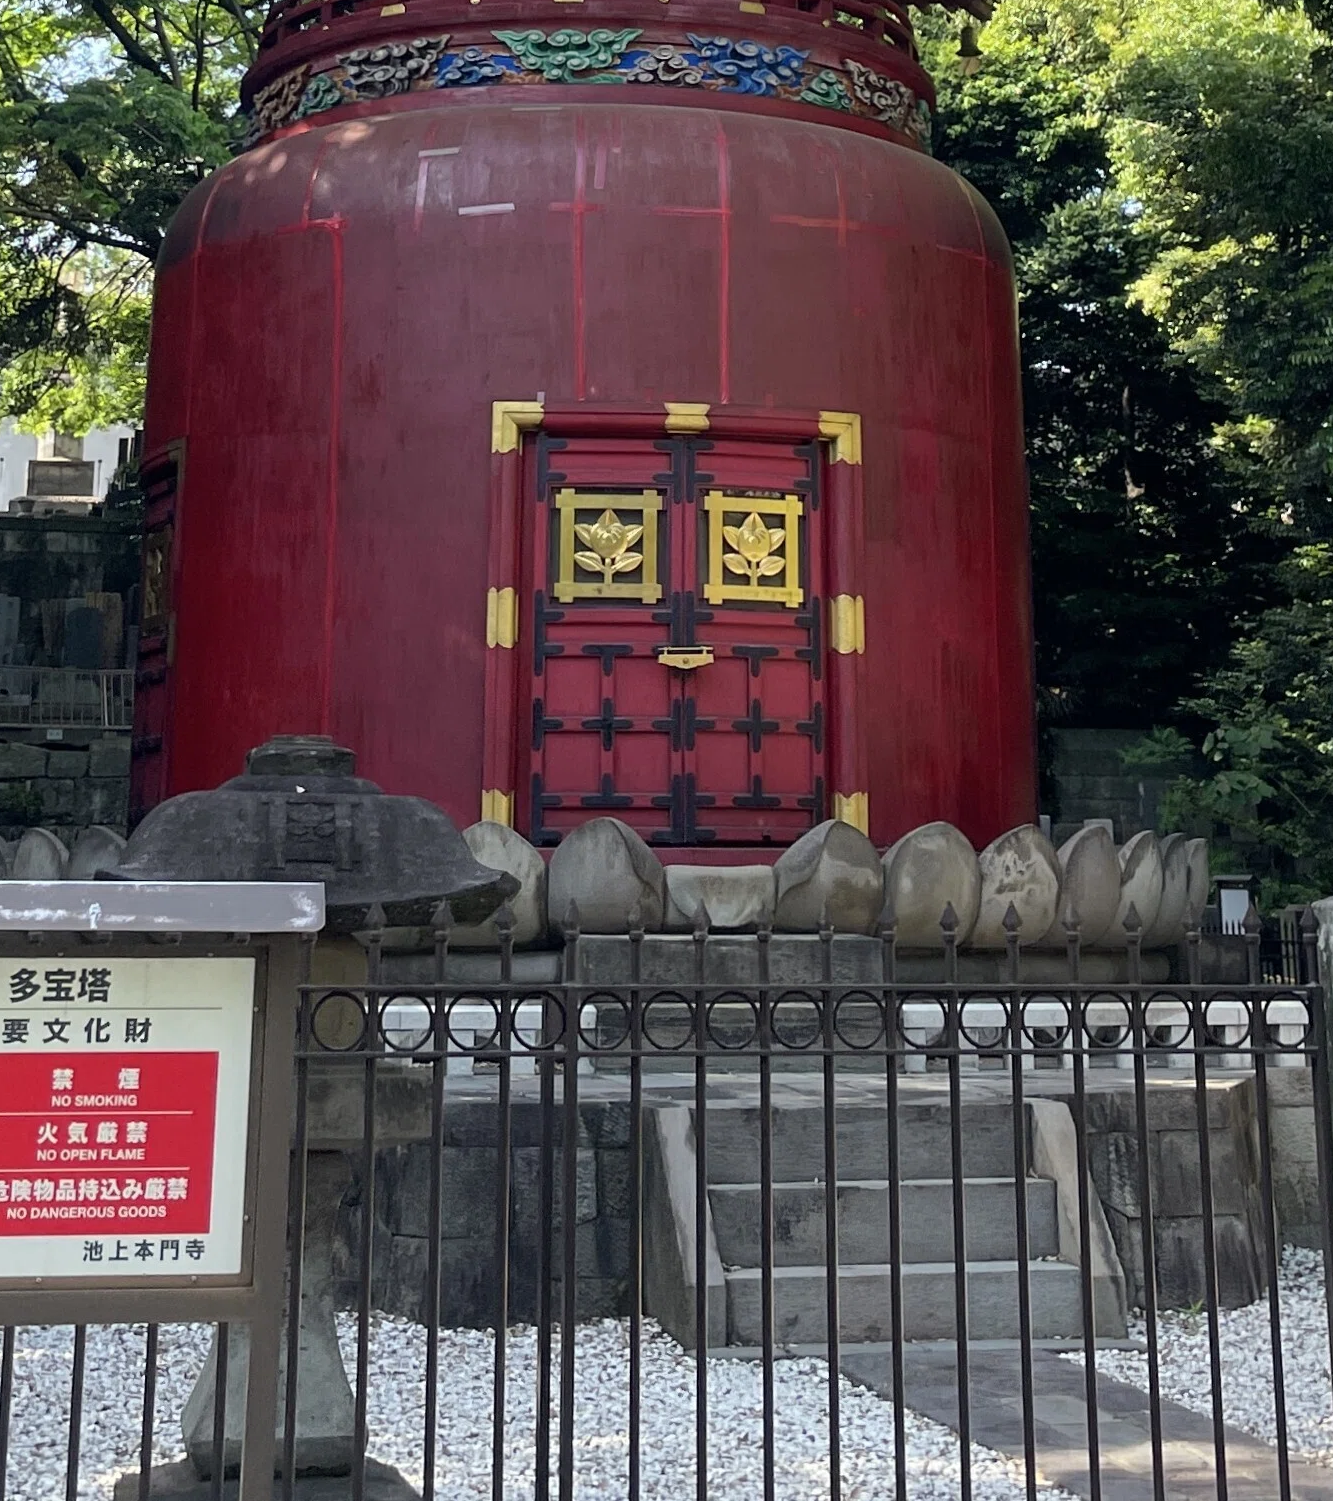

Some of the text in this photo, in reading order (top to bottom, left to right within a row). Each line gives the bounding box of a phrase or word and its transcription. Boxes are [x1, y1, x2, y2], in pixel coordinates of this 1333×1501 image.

[9, 968, 112, 1003] 多宝塔
[52, 1068, 141, 1090] 禁煙
[51, 1095, 138, 1107] NO SMOKING
[37, 1121, 148, 1145] 火気厳禁
[36, 1148, 146, 1161] NO OPEN FLAME
[6, 1205, 167, 1220] NO DANGEROUS GOODS
[82, 1239, 206, 1262] 池上本門寺
